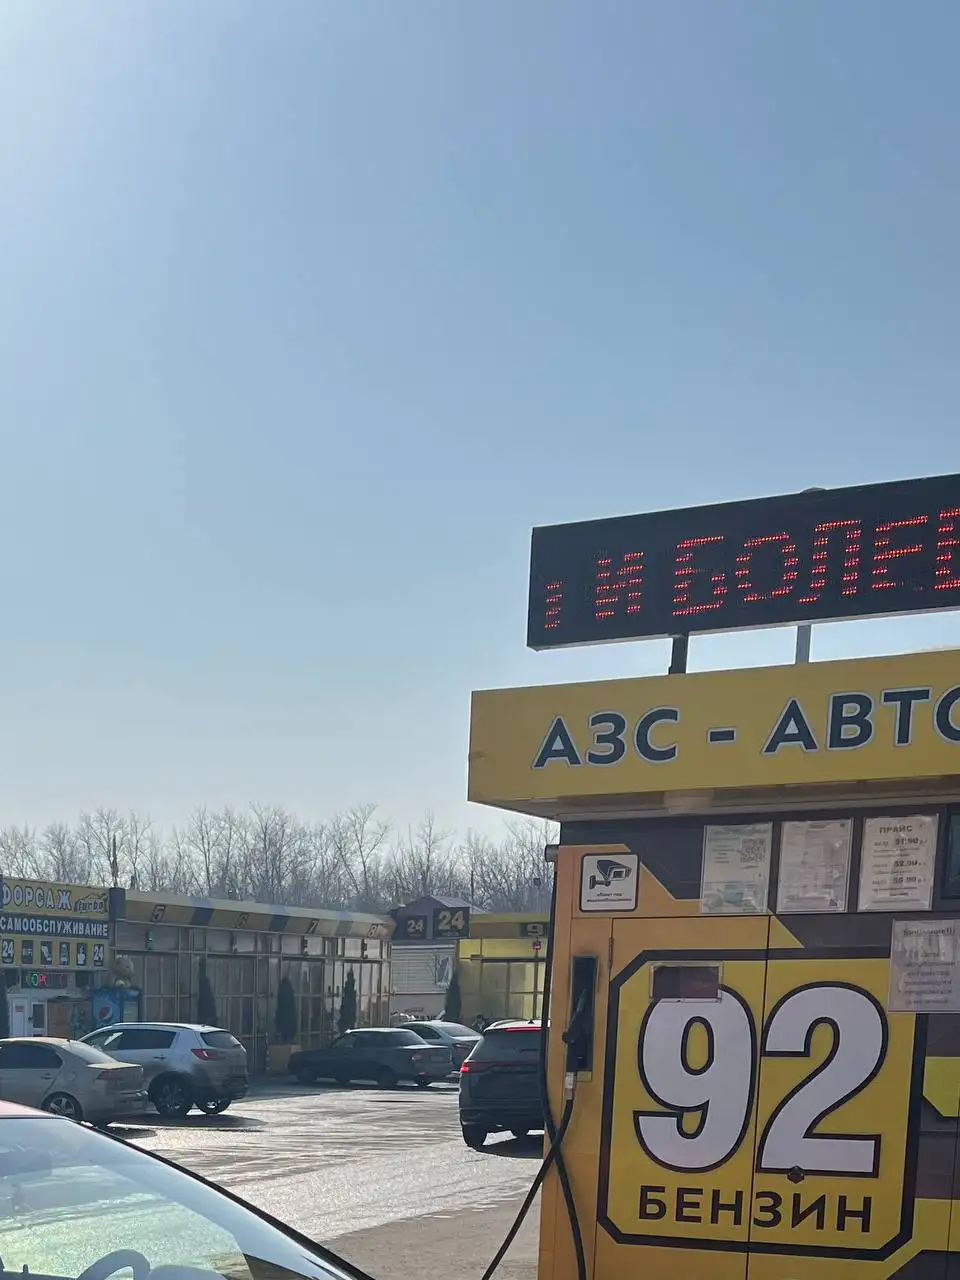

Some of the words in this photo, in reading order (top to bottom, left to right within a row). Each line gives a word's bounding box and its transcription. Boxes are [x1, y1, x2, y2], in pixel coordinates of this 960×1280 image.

[531, 706, 680, 770] АЗС
[152, 905, 166, 922] 5
[438, 910, 465, 931] 24
[308, 920, 319, 934] 7
[369, 924, 378, 937] 8
[407, 919, 425, 933] 24
[526, 923, 544, 936] 9
[2, 940, 15, 957] 24
[93, 944, 105, 961] 24
[633, 979, 890, 1179] 92
[638, 1184, 874, 1234] БЕНЗИН
